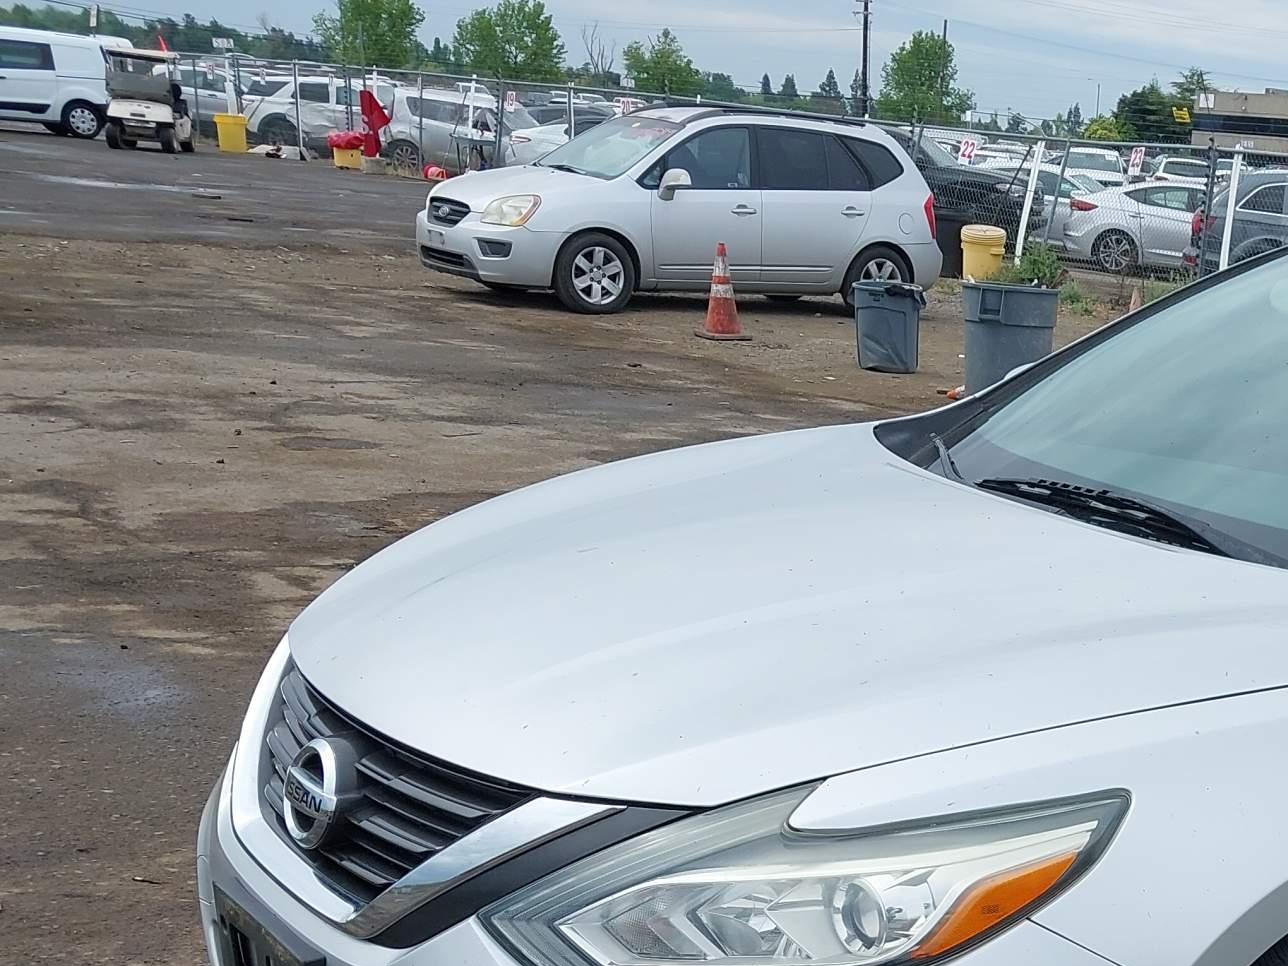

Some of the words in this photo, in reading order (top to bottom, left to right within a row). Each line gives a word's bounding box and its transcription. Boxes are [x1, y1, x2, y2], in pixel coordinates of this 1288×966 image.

[961, 140, 976, 159] 22
[1131, 148, 1143, 168] 23
[286, 779, 323, 814] SSAN
